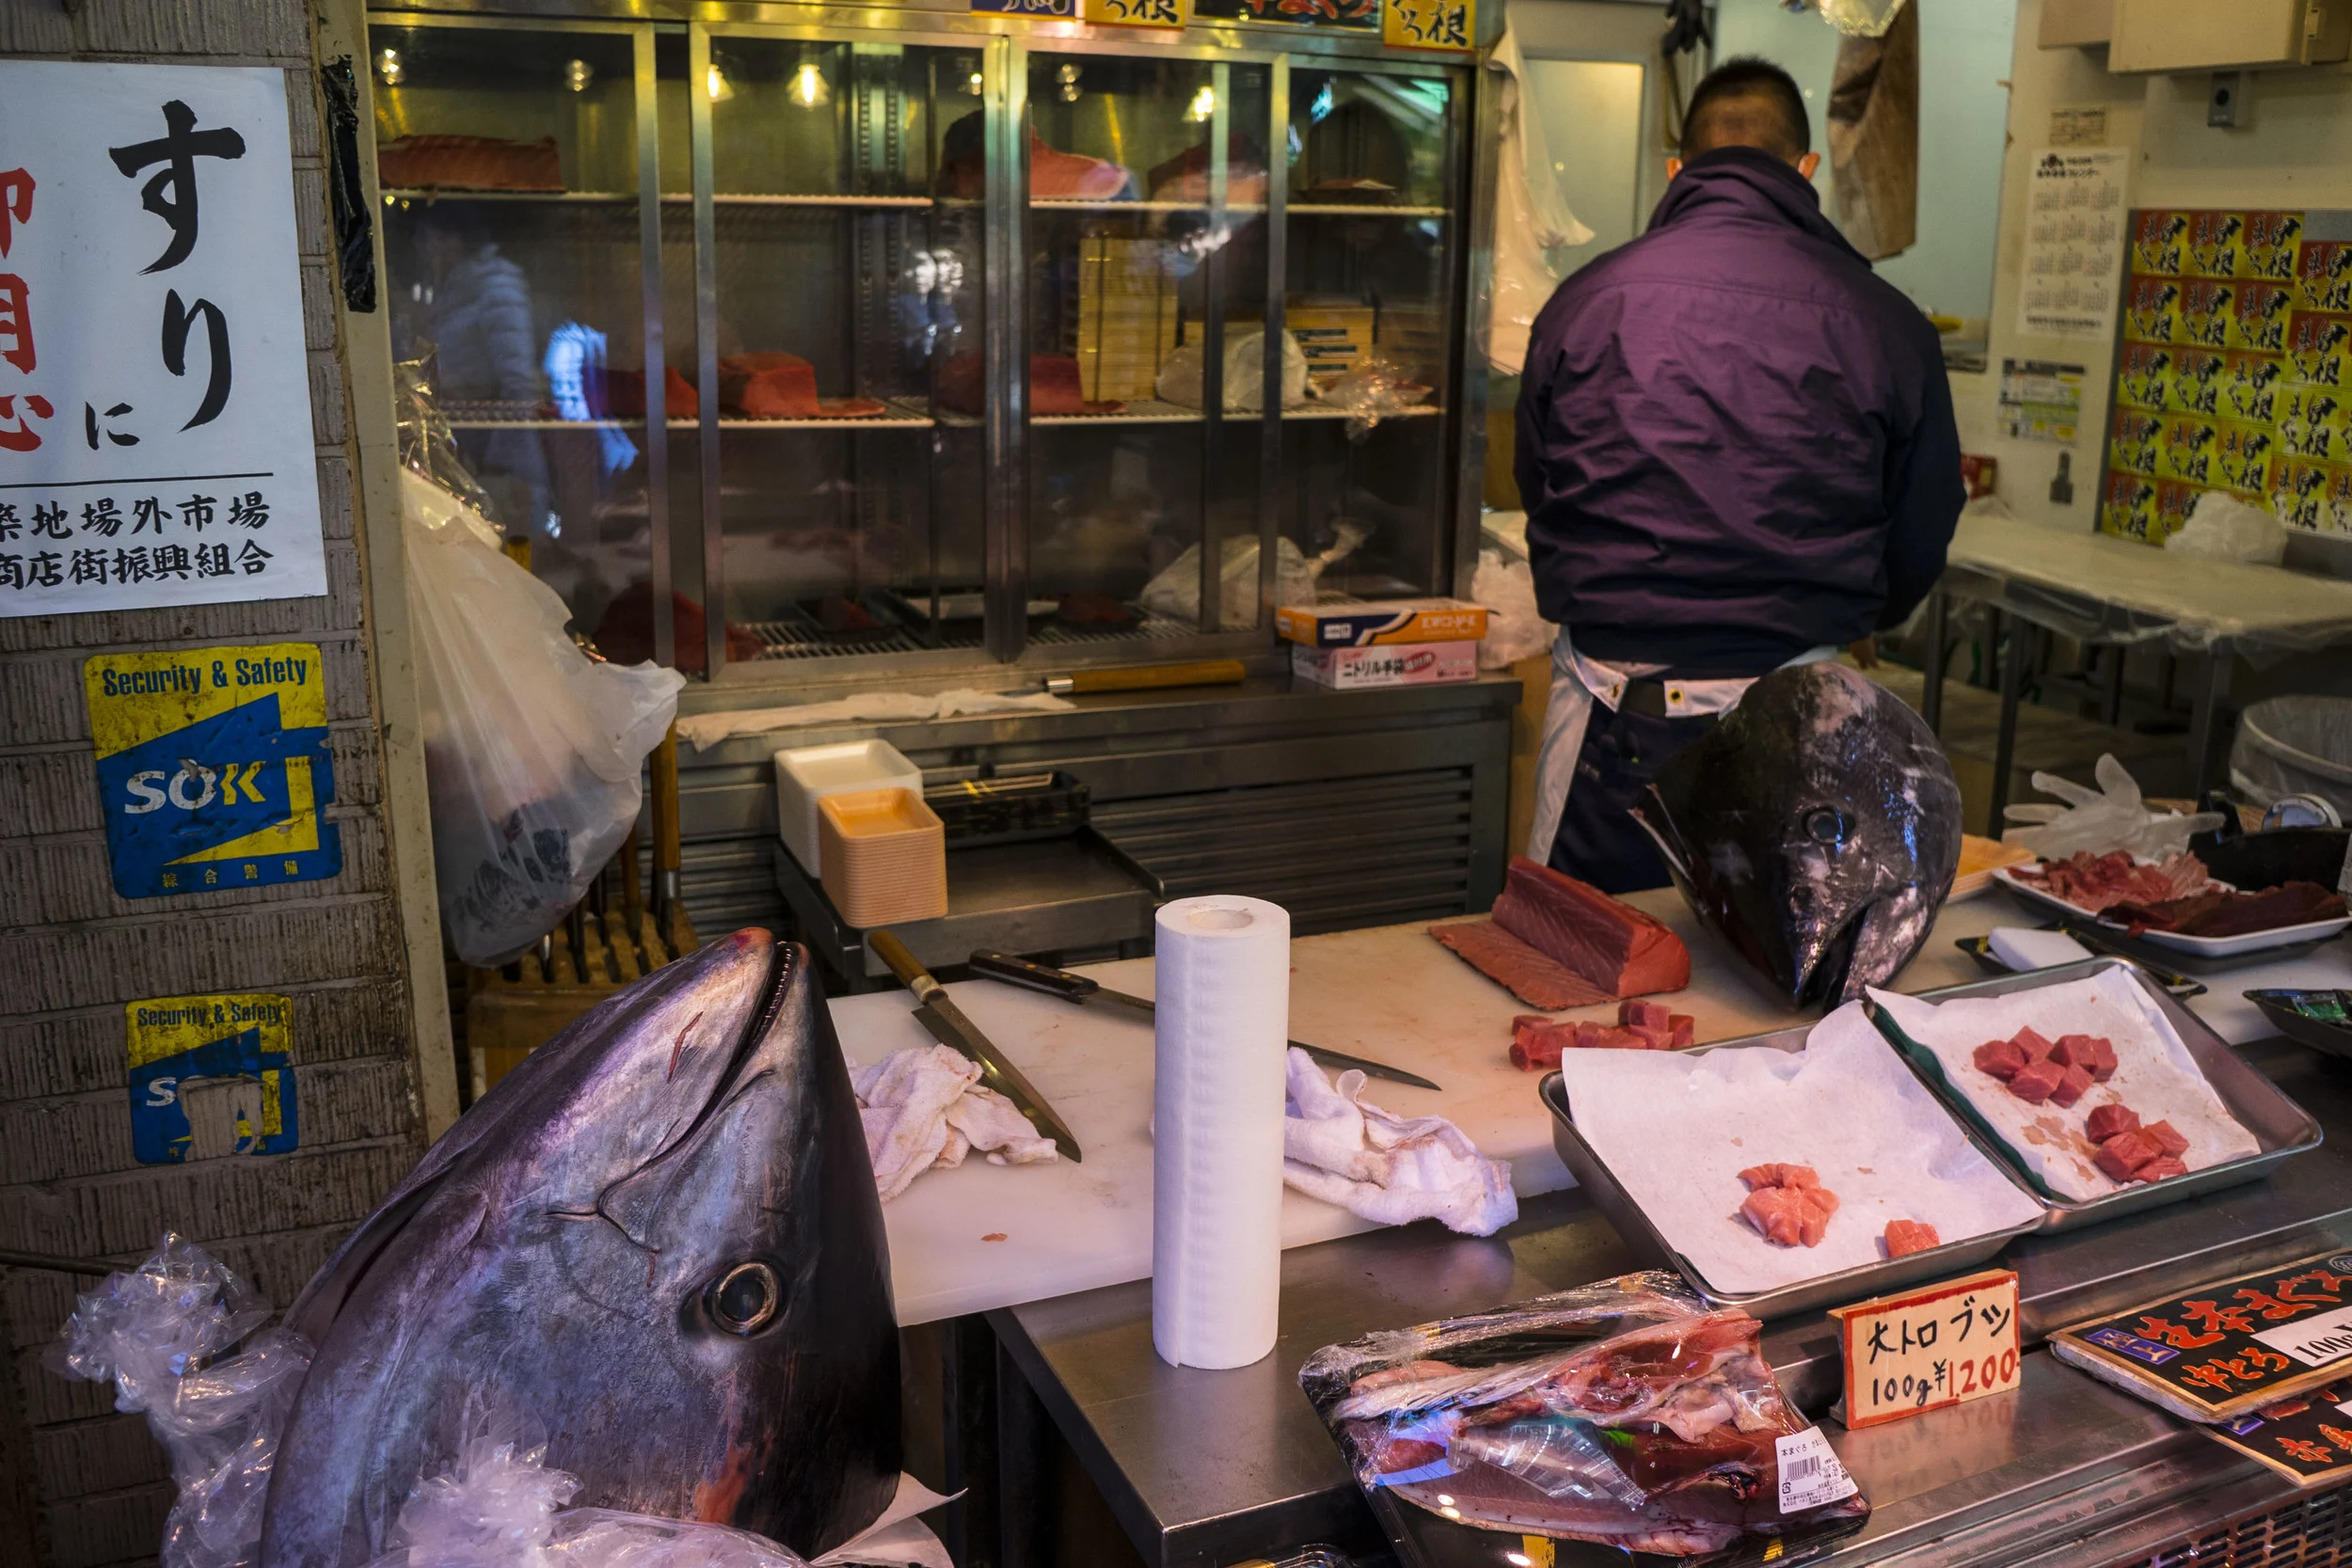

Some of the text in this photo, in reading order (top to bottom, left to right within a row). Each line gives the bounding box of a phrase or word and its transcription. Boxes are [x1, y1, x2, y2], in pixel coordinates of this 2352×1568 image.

[109, 100, 246, 433] すり
[102, 657, 307, 696] Security & Safety
[136, 1003, 281, 1026] Security & Safety
